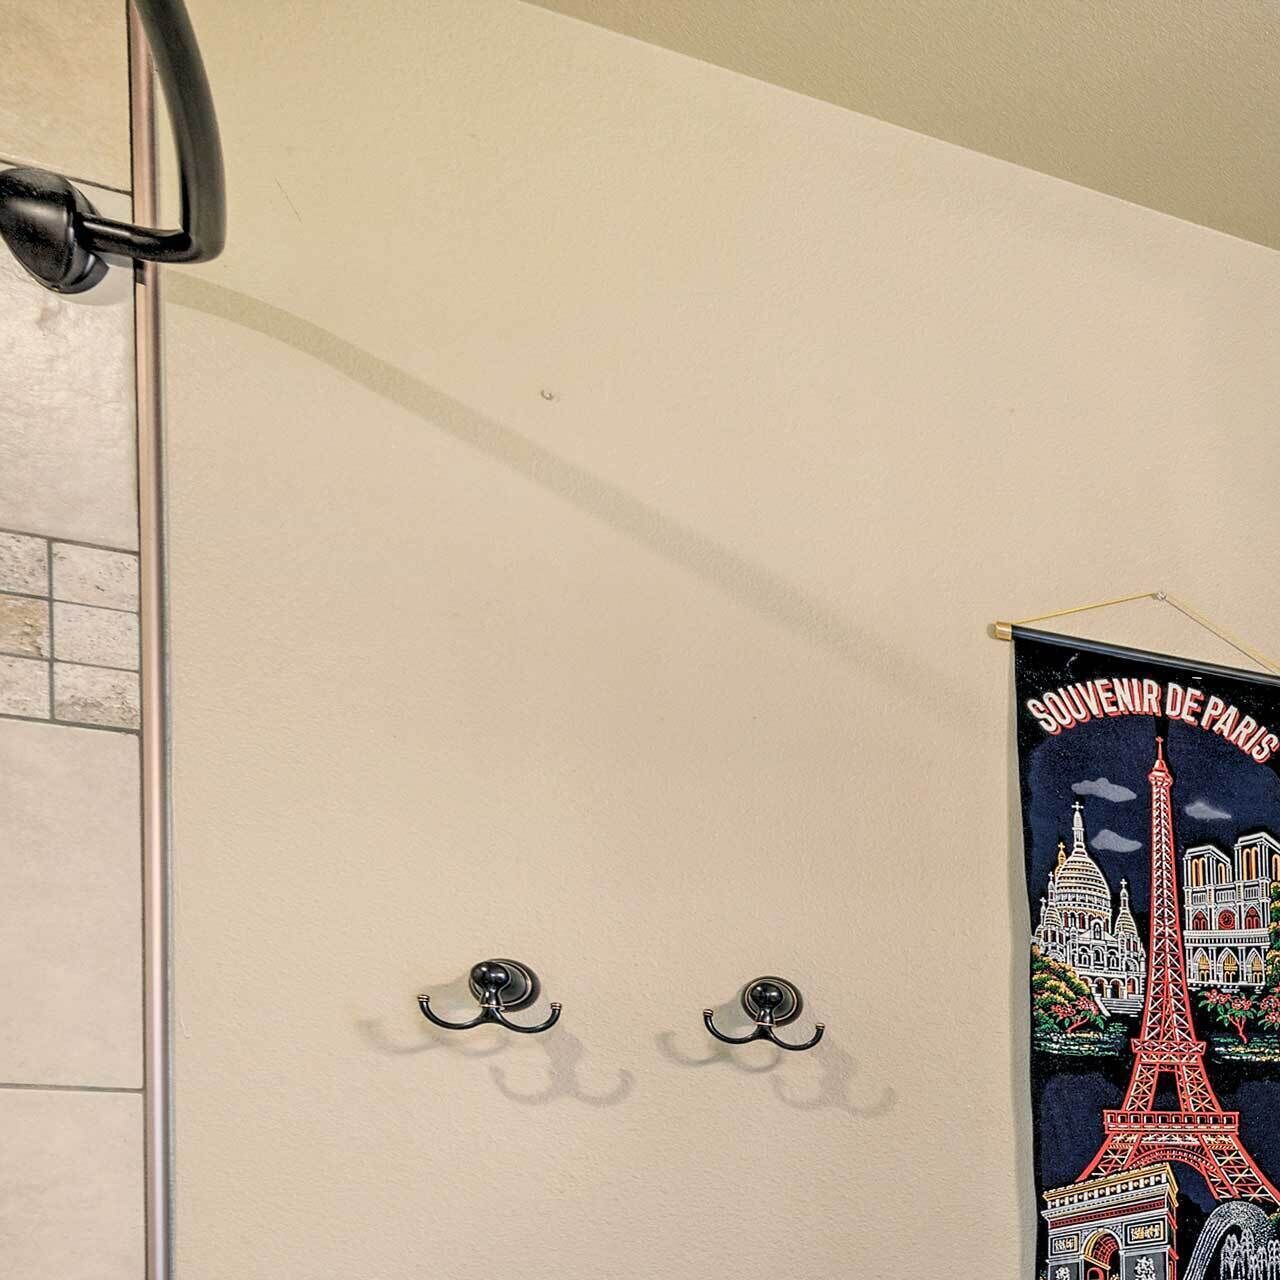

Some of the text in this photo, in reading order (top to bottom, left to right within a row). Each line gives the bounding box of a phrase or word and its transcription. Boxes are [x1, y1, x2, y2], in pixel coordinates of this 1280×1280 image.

[1027, 678, 1280, 764] SOUVENIR DE PARIS
